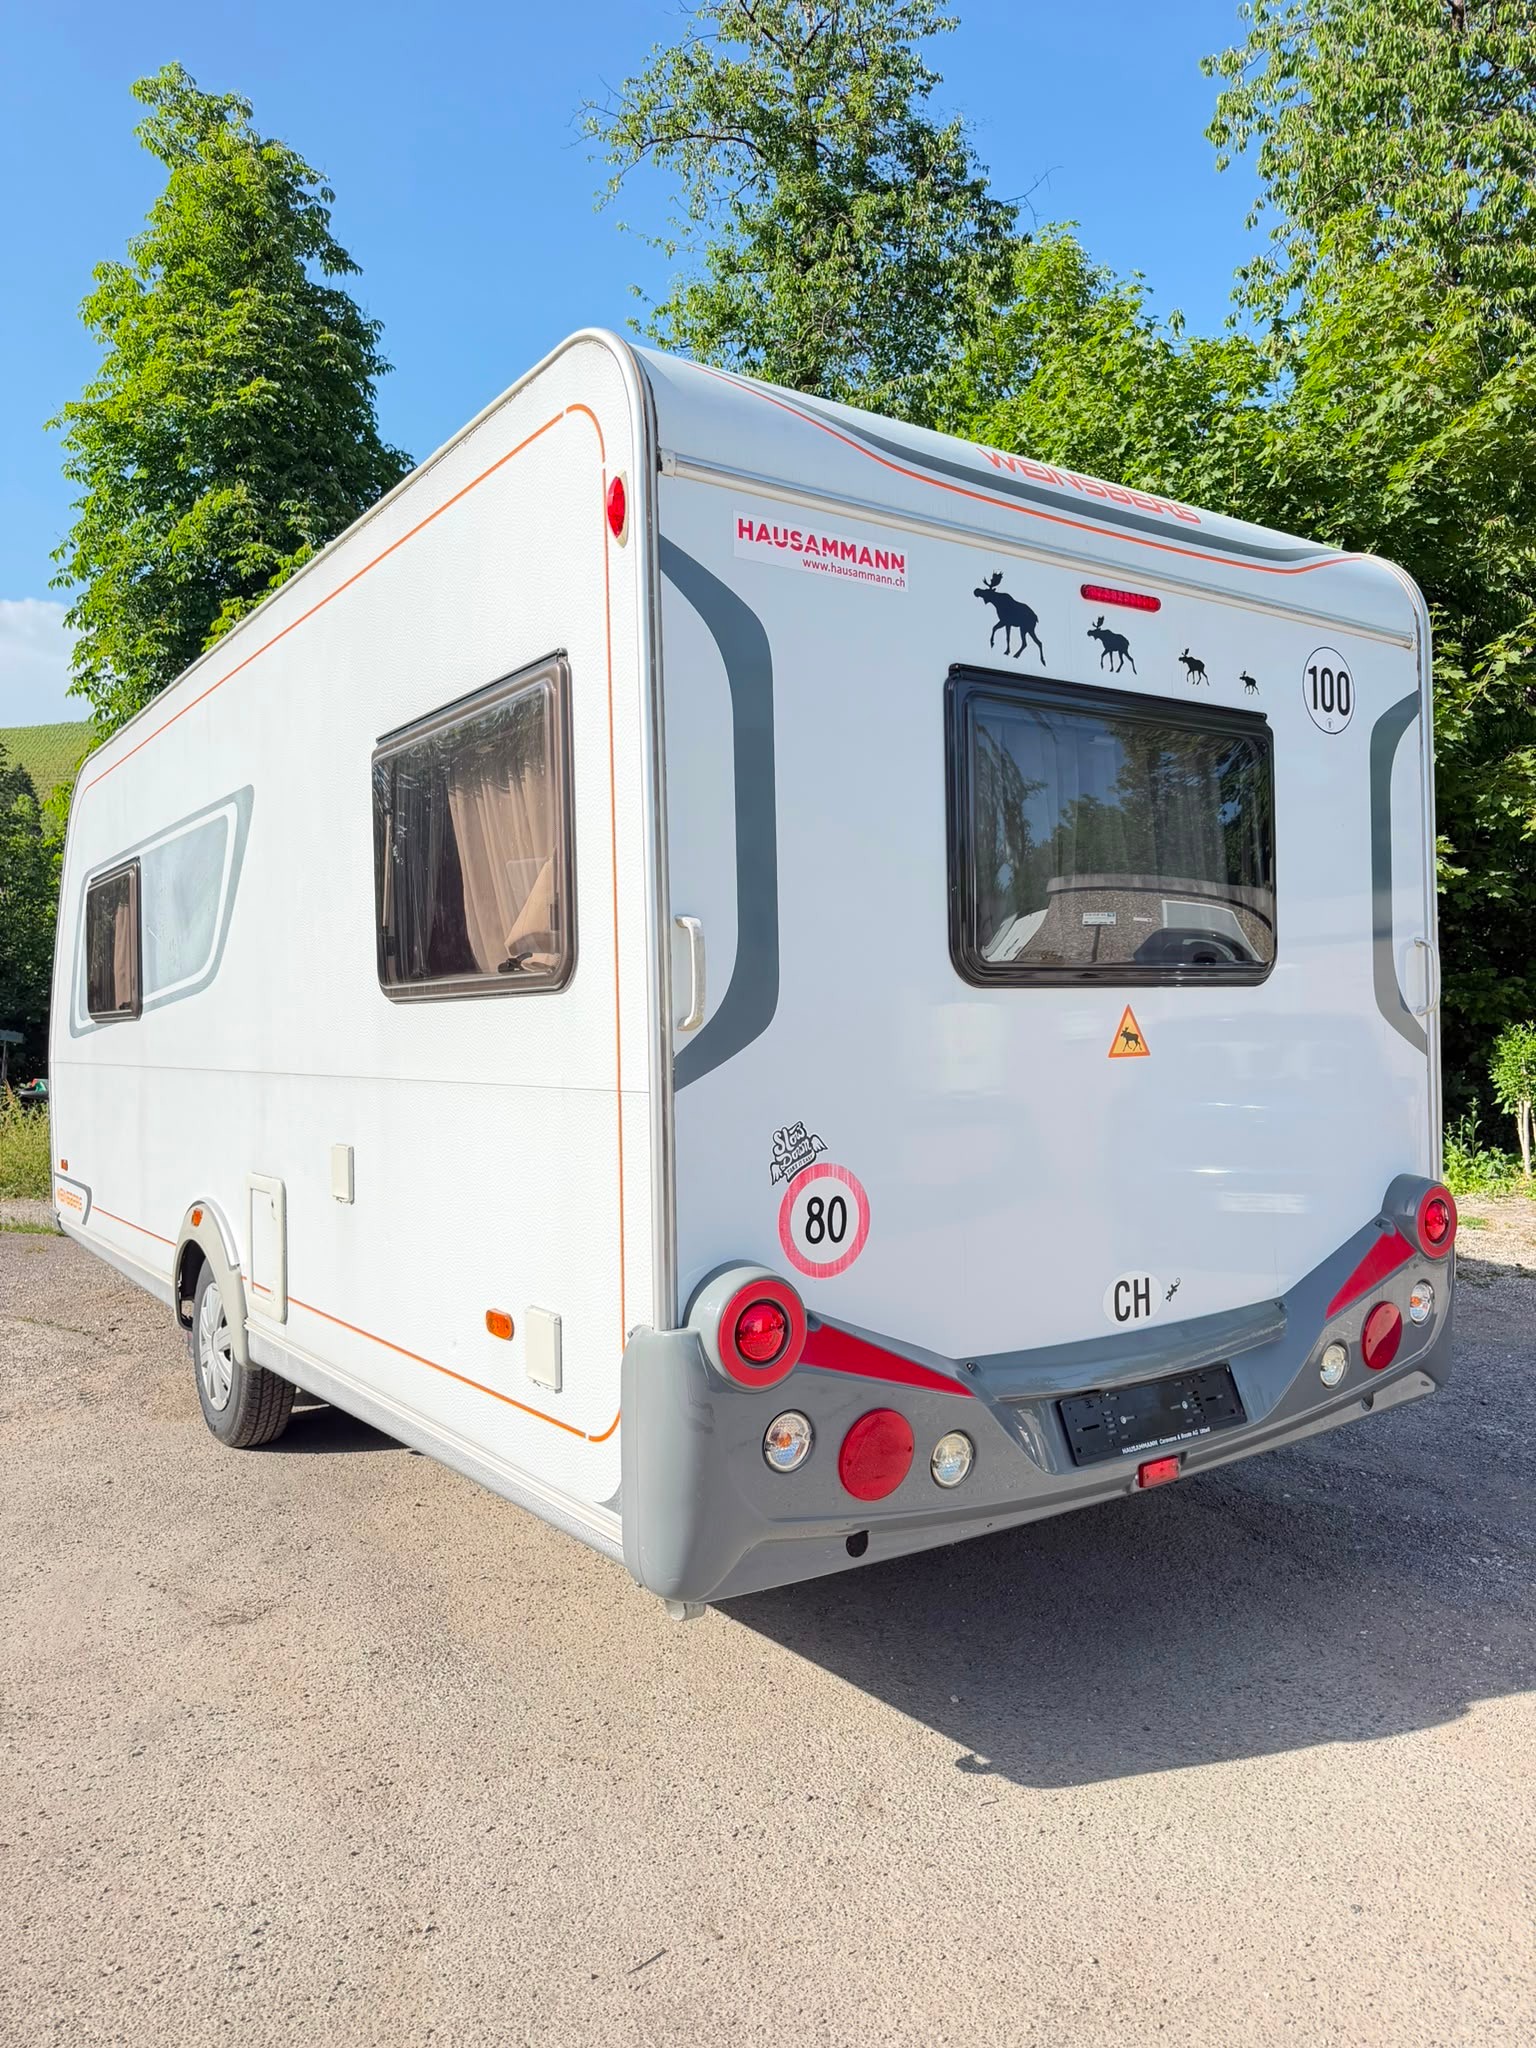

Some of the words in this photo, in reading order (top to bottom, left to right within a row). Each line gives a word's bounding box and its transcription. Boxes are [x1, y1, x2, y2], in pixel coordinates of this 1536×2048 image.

[976, 448, 1201, 524] WEINSBERG
[738, 518, 905, 574] HAUSAMMANN
[802, 558, 906, 588] www.hausammann.ch
[1308, 665, 1350, 716] 100
[806, 1196, 848, 1244] 80
[1114, 1277, 1150, 1322] CH
